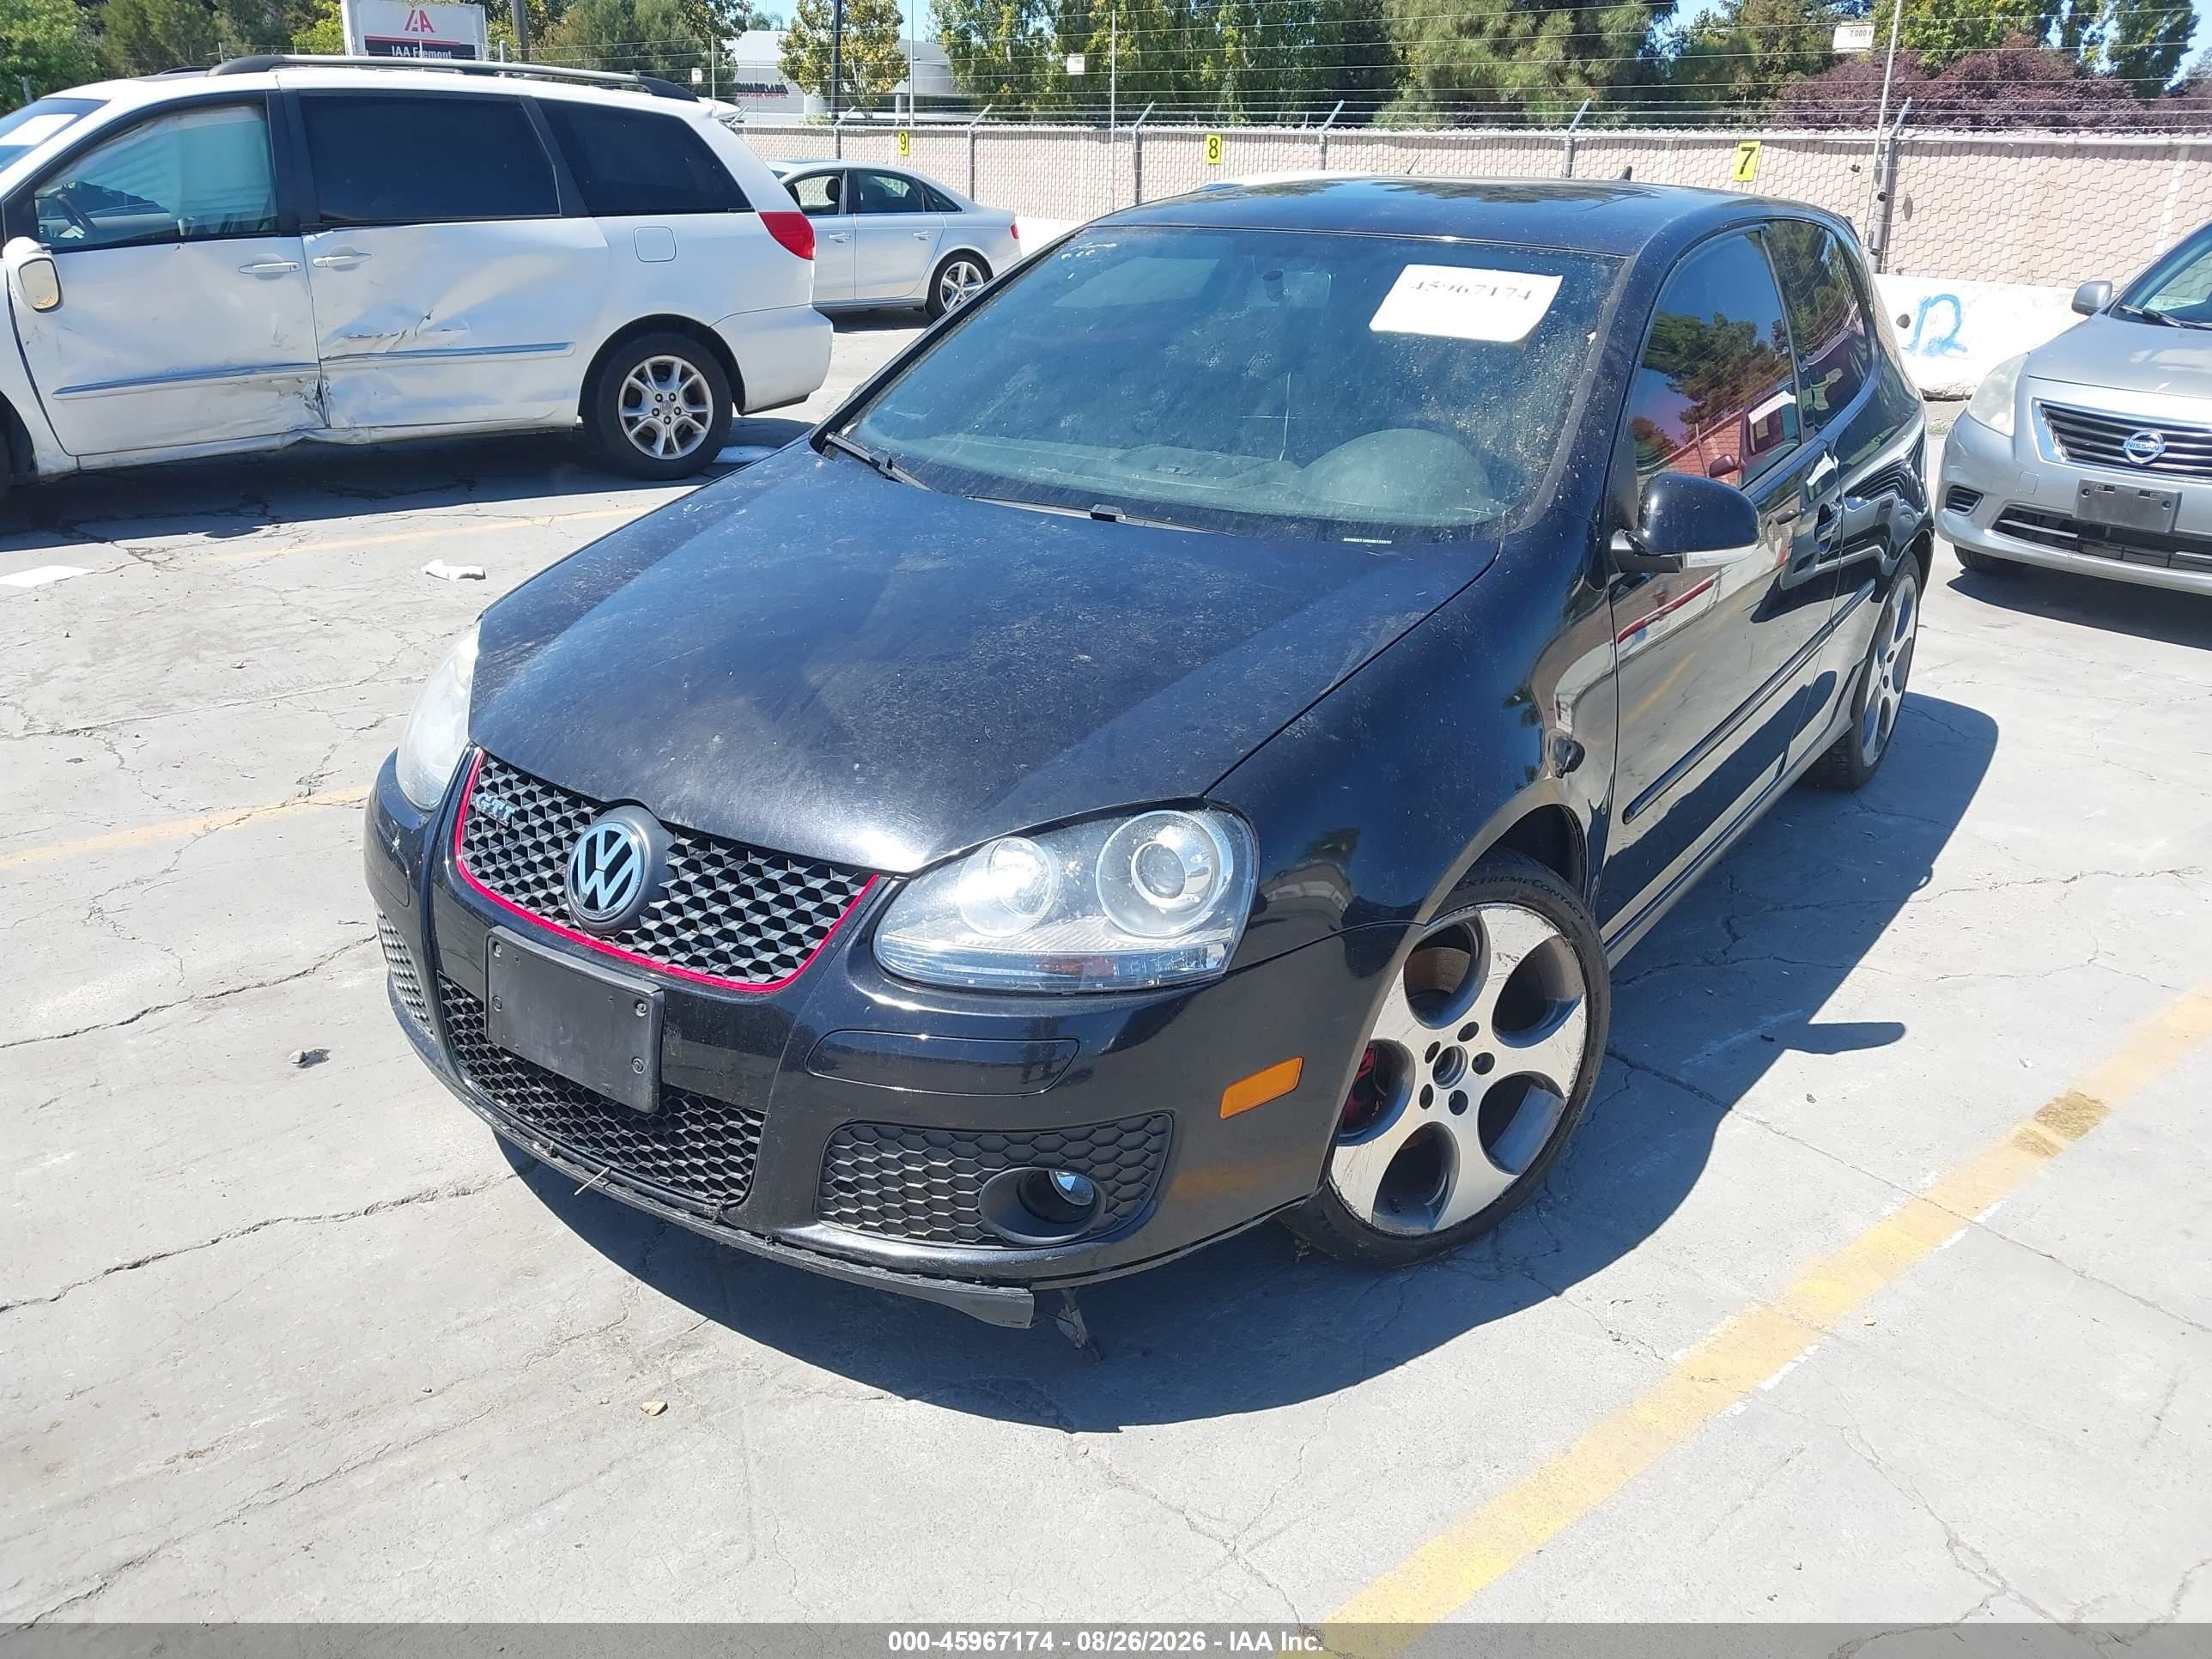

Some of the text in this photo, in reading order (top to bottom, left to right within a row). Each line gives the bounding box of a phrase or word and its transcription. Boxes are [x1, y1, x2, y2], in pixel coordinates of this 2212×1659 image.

[392, 45, 410, 57] IAA
[900, 133, 907, 151] 9
[1209, 137, 1218, 159] 8
[1739, 146, 1757, 175] 7
[2126, 441, 2160, 451] NISSAN
[475, 793, 516, 827] GTI
